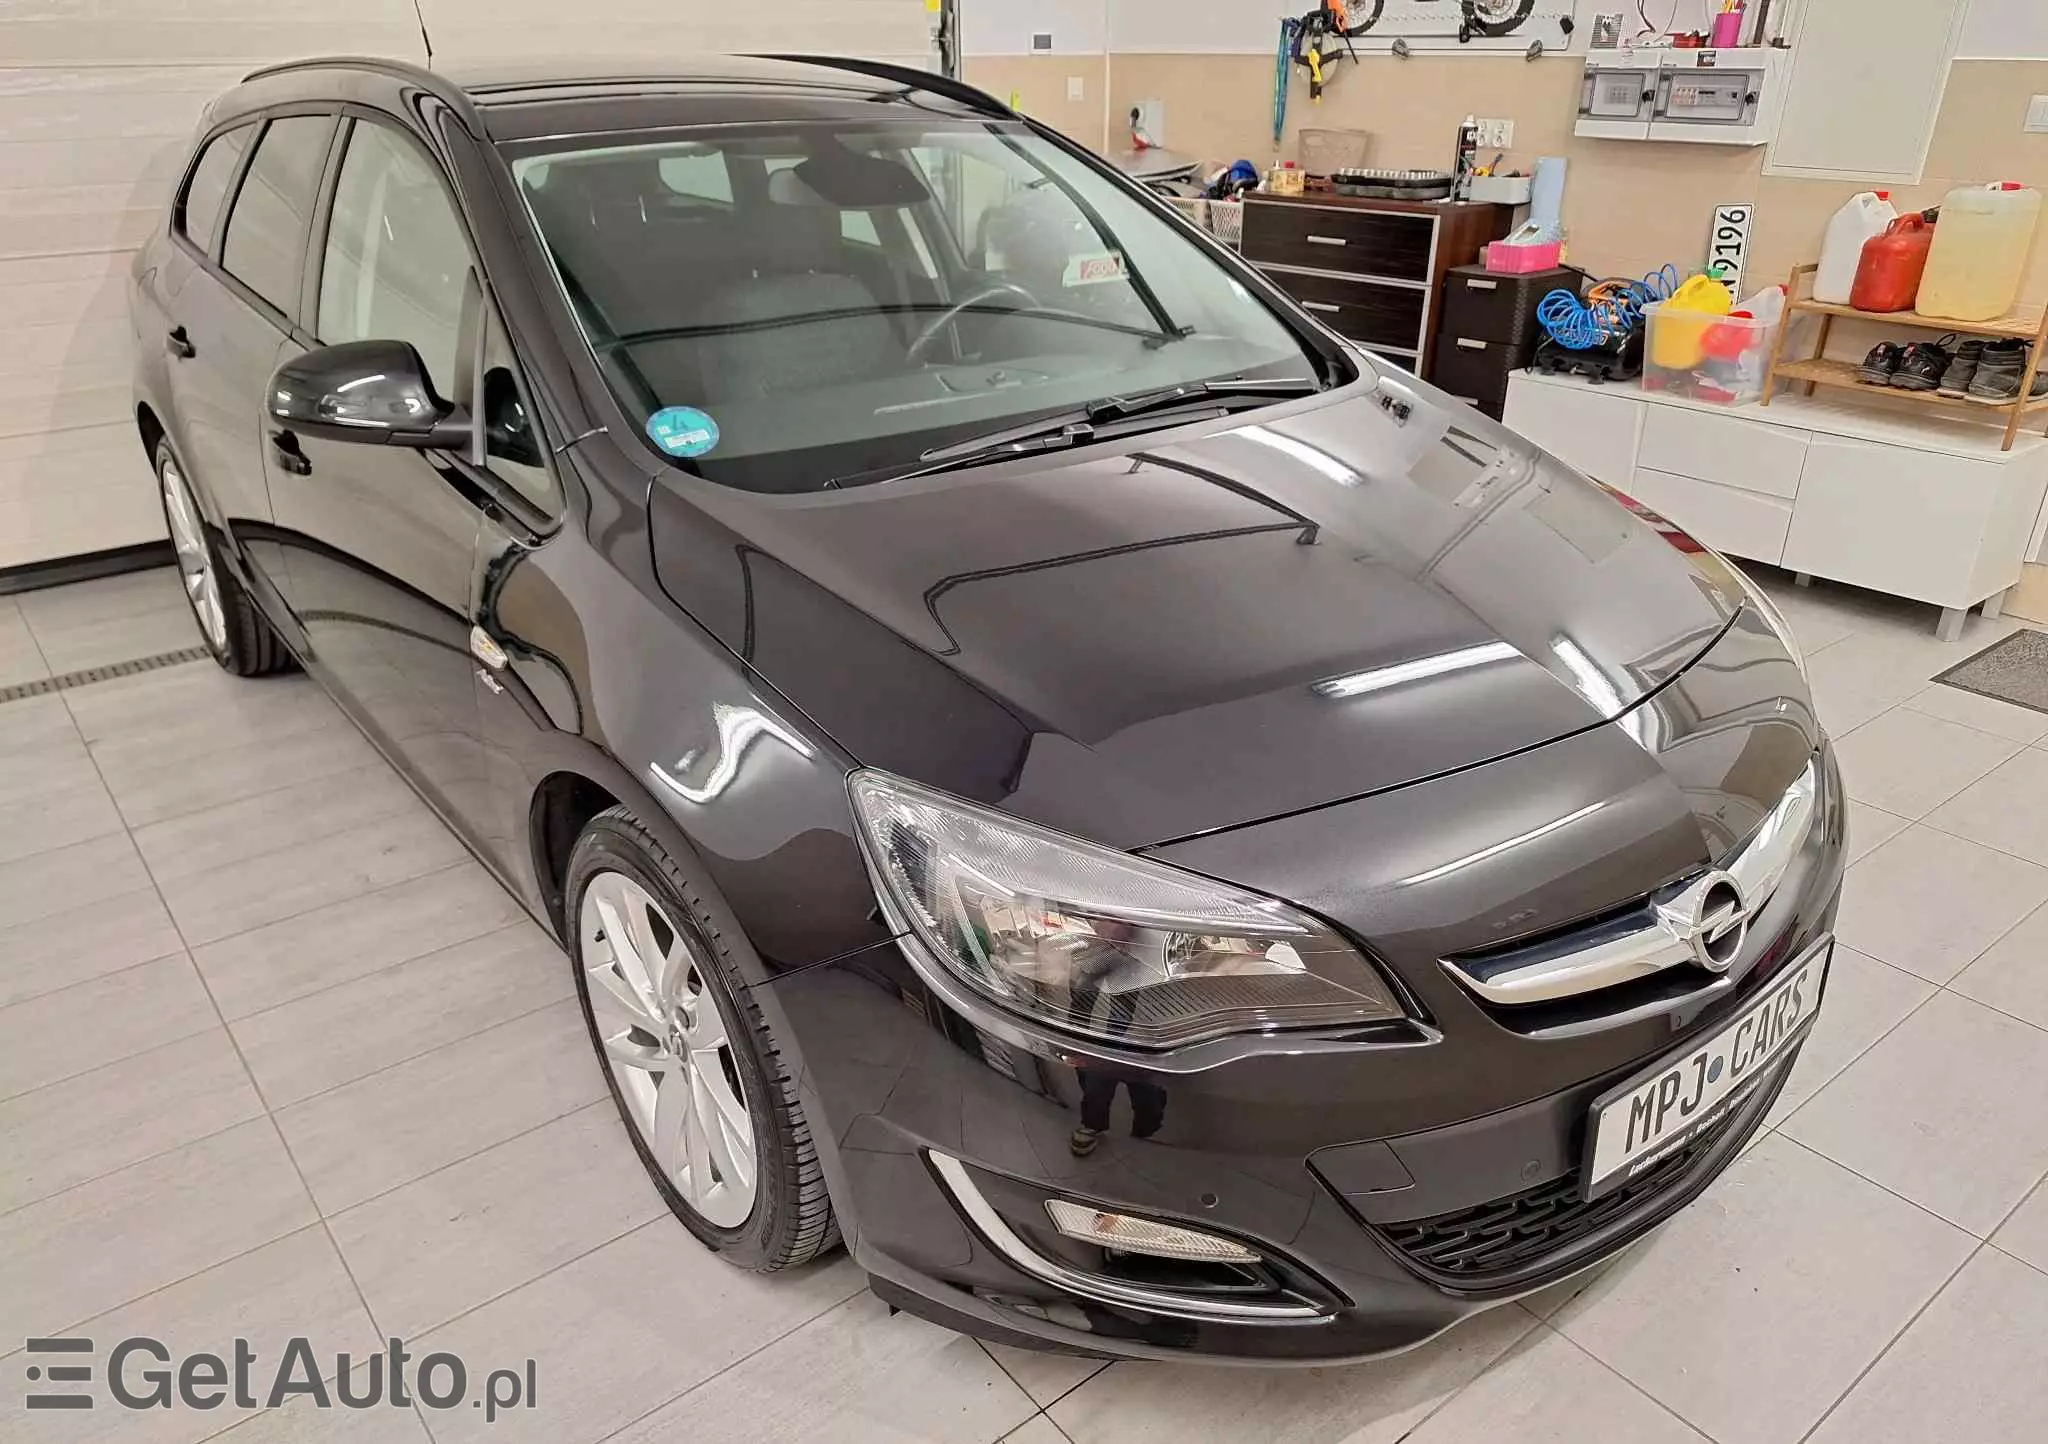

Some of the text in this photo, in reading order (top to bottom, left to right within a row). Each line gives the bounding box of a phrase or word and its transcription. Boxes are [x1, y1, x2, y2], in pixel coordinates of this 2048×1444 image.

[1713, 209, 1746, 271] 9196
[1625, 969, 1808, 1154] MPJ CARS
